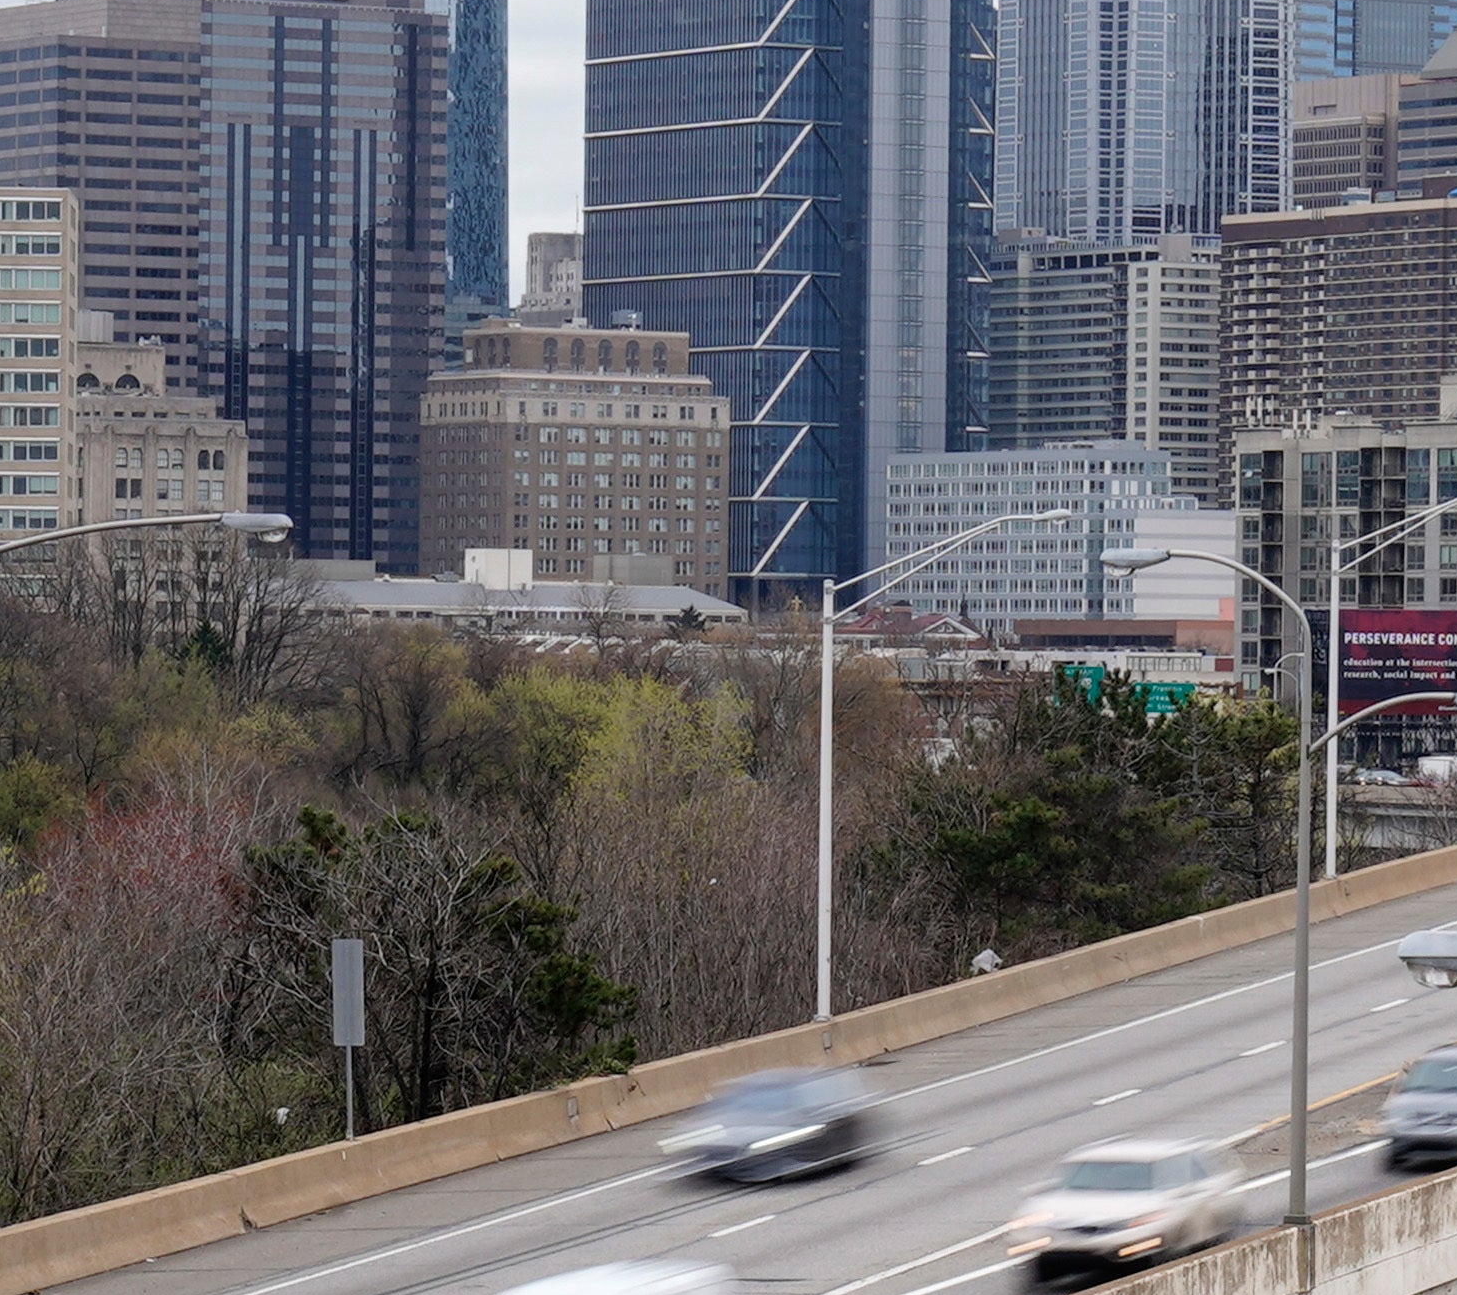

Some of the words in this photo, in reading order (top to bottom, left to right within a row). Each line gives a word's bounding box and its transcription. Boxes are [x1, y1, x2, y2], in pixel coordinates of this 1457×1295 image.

[1344, 632, 1436, 645] PERSEVERANCE
[1343, 658, 1383, 667] education
[1397, 658, 1410, 667] the
[1383, 670, 1407, 679] social
[1410, 671, 1438, 680] impact
[1441, 671, 1455, 679] and
